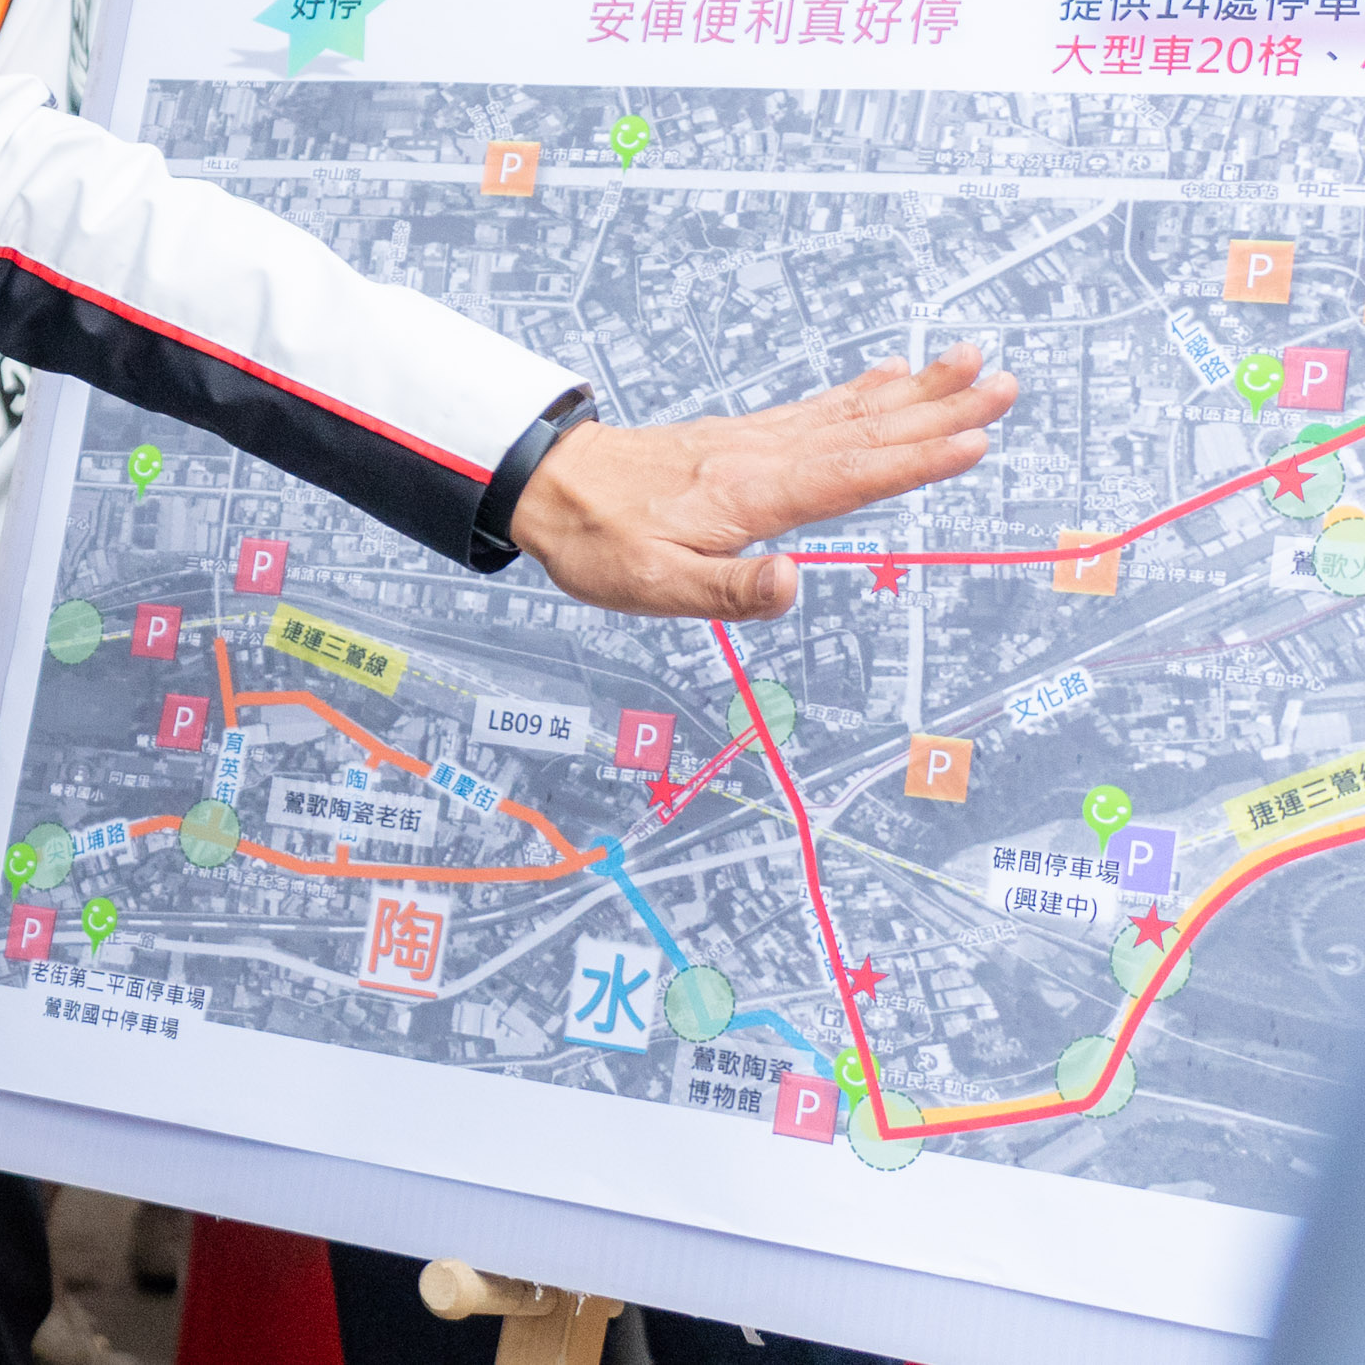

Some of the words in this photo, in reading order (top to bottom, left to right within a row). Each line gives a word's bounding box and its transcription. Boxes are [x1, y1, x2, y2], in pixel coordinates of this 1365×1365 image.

[958, 182, 1020, 199] 中山路
[283, 617, 389, 679] 捷運三鶯線
[1009, 671, 1088, 724] 文化路
[488, 709, 543, 735] LB09
[549, 715, 572, 741] 站
[215, 731, 245, 806] 育英街
[430, 762, 499, 812] 重慶街
[282, 789, 422, 833] 鶯歌陶瓷老街
[993, 845, 1120, 886] 礫間停車場
[1004, 886, 1098, 924] (興建中)
[367, 897, 444, 982] 陶
[31, 961, 206, 1011] 老街第二平面停車場
[573, 952, 651, 1034] 水
[42, 995, 180, 1040] 鶯歌國中停車場
[688, 1077, 763, 1114] 博物館
